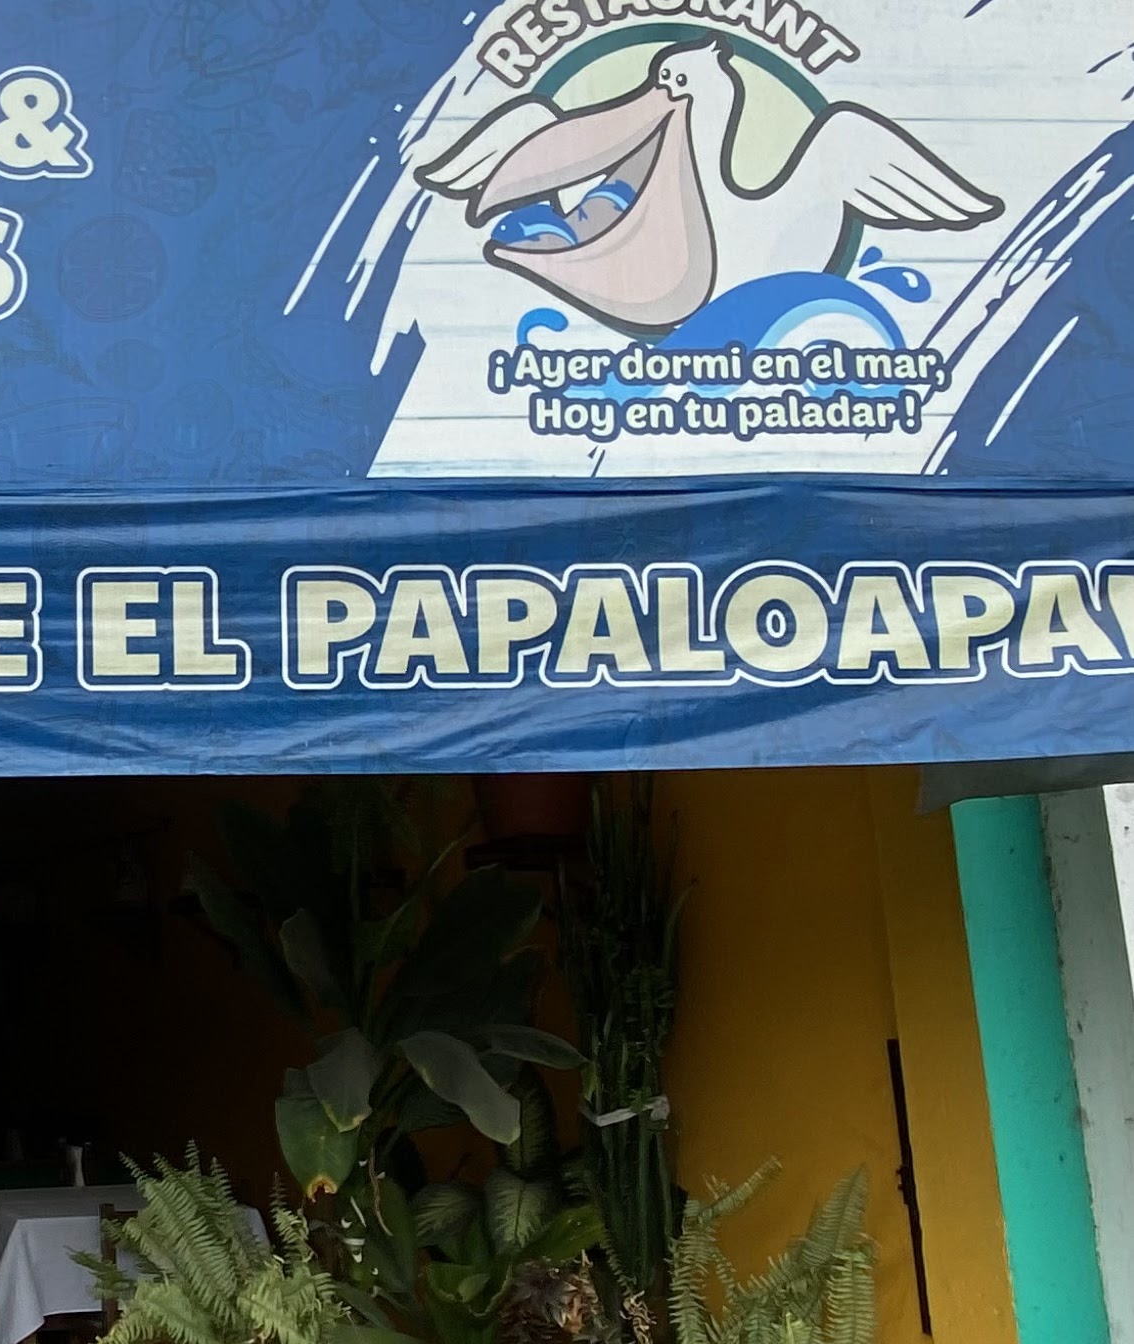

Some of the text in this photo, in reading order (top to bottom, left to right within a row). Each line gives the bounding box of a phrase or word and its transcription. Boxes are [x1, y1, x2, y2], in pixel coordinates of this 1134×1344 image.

[618, 346, 742, 381] dormi
[750, 353, 802, 381] en
[809, 349, 848, 381] el
[853, 353, 947, 385] mar,
[535, 397, 616, 434] Hoy
[624, 405, 676, 431] en
[683, 399, 729, 430] tu
[85, 575, 252, 684] EL
[288, 567, 1134, 681] PAPALOAPA
